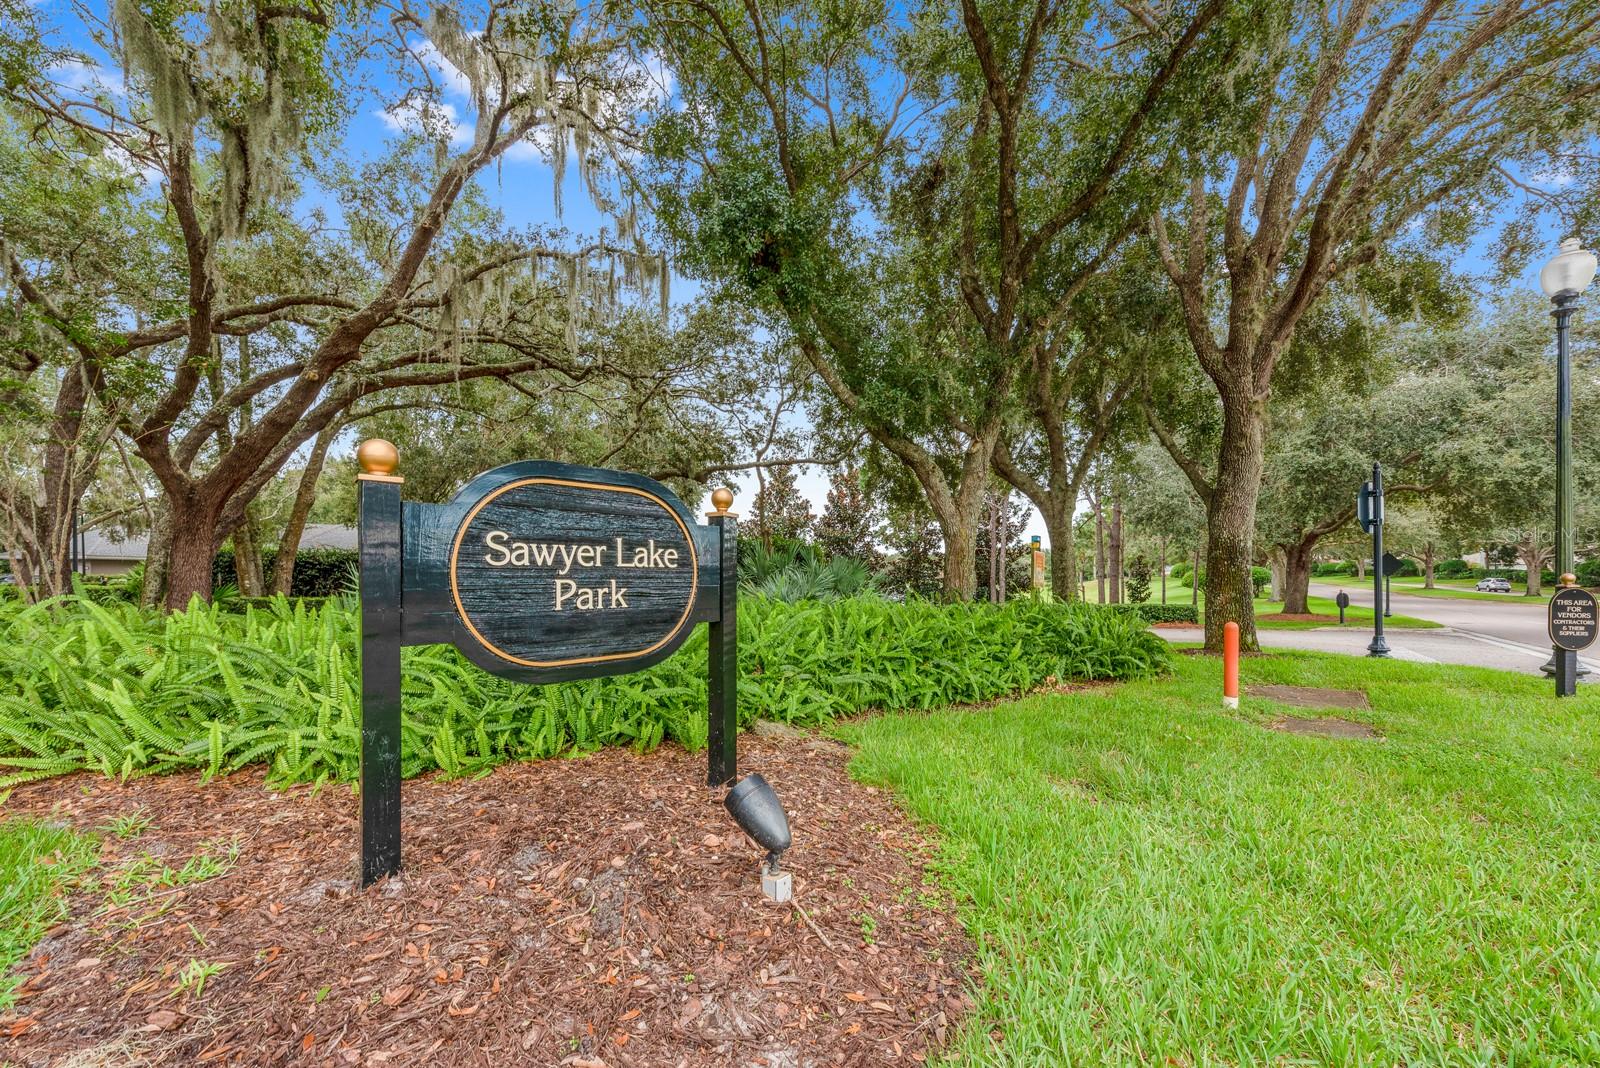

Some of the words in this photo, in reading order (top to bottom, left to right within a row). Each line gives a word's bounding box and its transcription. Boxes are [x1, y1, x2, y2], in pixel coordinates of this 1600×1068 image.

[484, 530, 607, 576] Sawyer
[616, 537, 678, 569] Lake
[553, 578, 629, 611] Park
